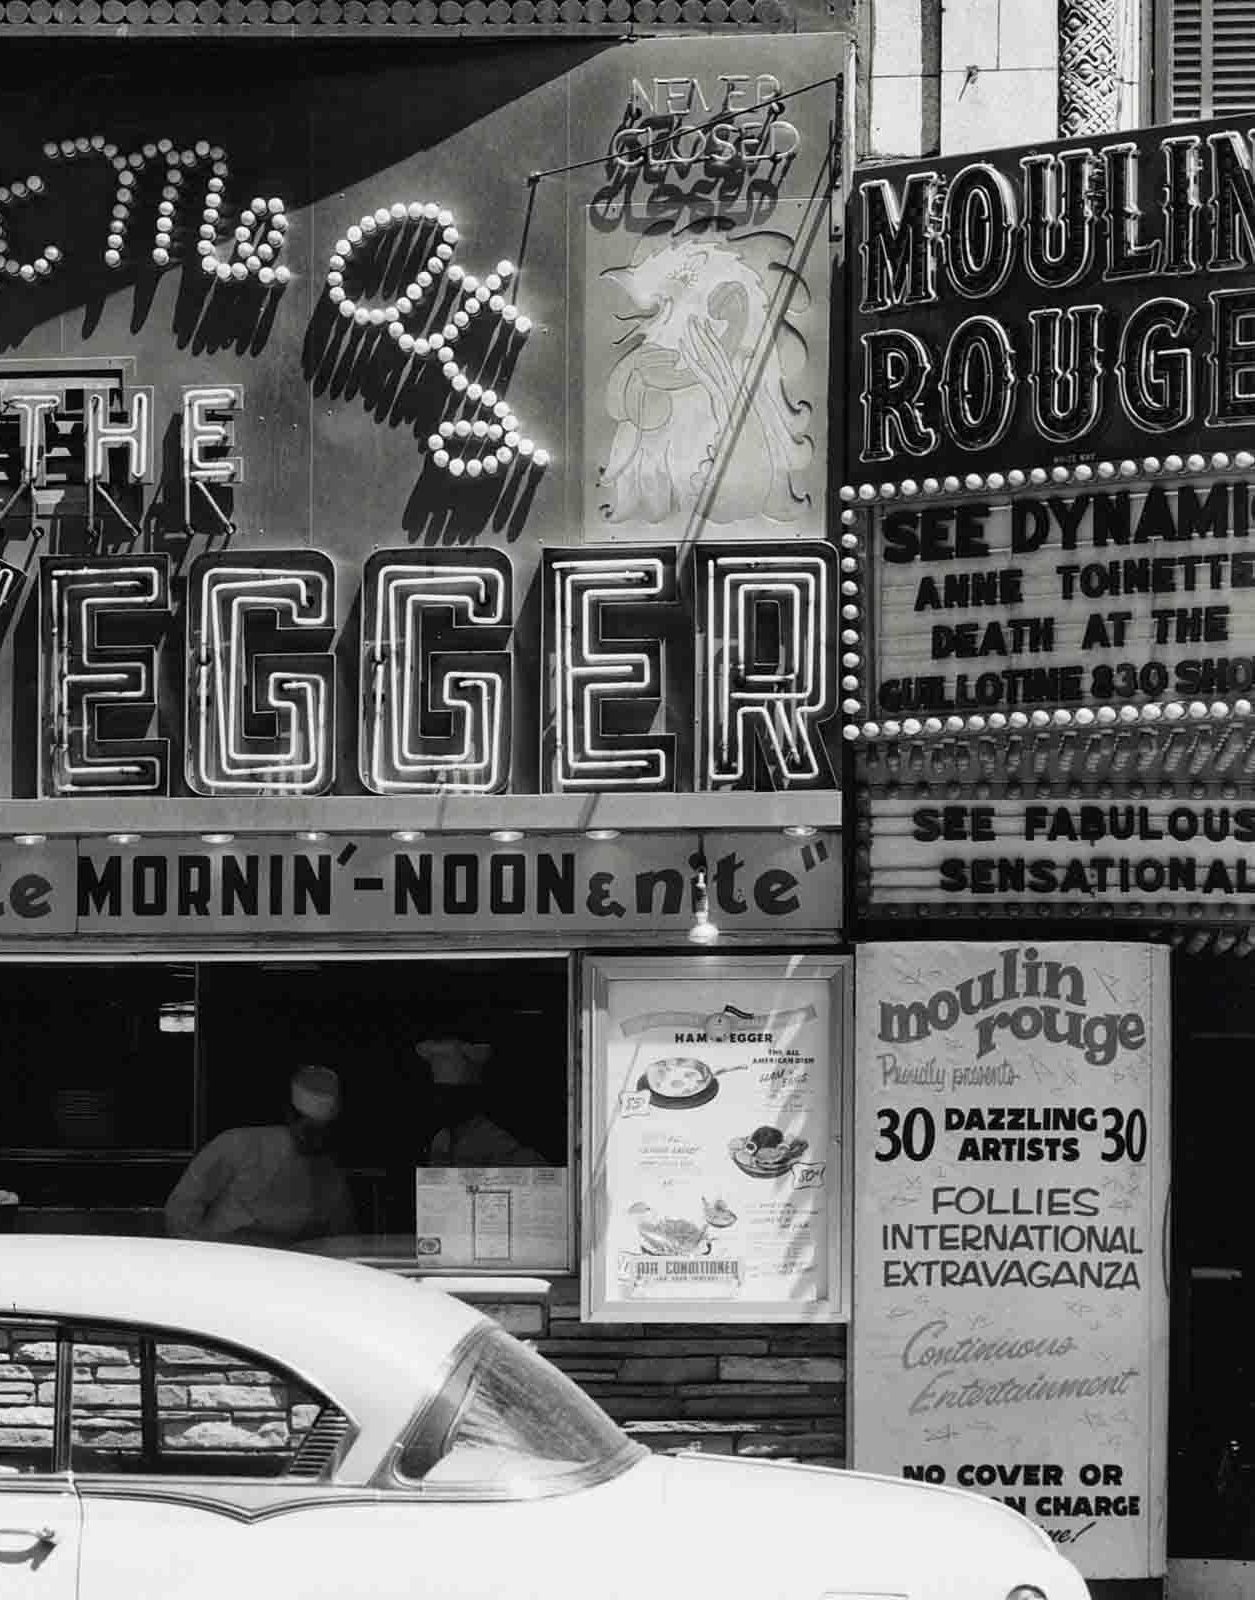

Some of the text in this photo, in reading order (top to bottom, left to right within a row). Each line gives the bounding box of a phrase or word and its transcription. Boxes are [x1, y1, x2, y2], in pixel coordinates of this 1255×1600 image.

[630, 73, 782, 115] NEVER
[611, 120, 802, 168] CLOSED
[857, 286, 1255, 464] ROUGE
[0, 384, 245, 486] THE
[882, 481, 1255, 565] SEE DYNAMI
[913, 550, 1255, 612] ANNE TOINETTE
[931, 605, 1231, 661] DEATH AT THE
[37, 540, 842, 799] EGGER
[1090, 661, 1170, 699] 830
[1174, 656, 1255, 697] SHO
[912, 805, 1255, 843] SEE FABULOUS
[939, 856, 1255, 894] SENSATIONAL
[877, 947, 1087, 1044] moulin
[674, 1032, 708, 1044] HAM
[729, 1032, 773, 1044] EGGER
[975, 1005, 1146, 1067] rouge
[873, 1105, 1147, 1164] 30 DAZZLING 30
[956, 1135, 1081, 1163] ARTISTS
[931, 1186, 1100, 1218] FOLLIES
[881, 1223, 1144, 1257] INTERNATIONAL
[881, 1259, 1142, 1292] EXTRAVAGANZA
[900, 1319, 1079, 1372] Continuous
[907, 1366, 1141, 1418] Entertainment
[901, 1463, 1124, 1487] NO COVER OR
[1035, 1495, 1141, 1518] CHARGE
